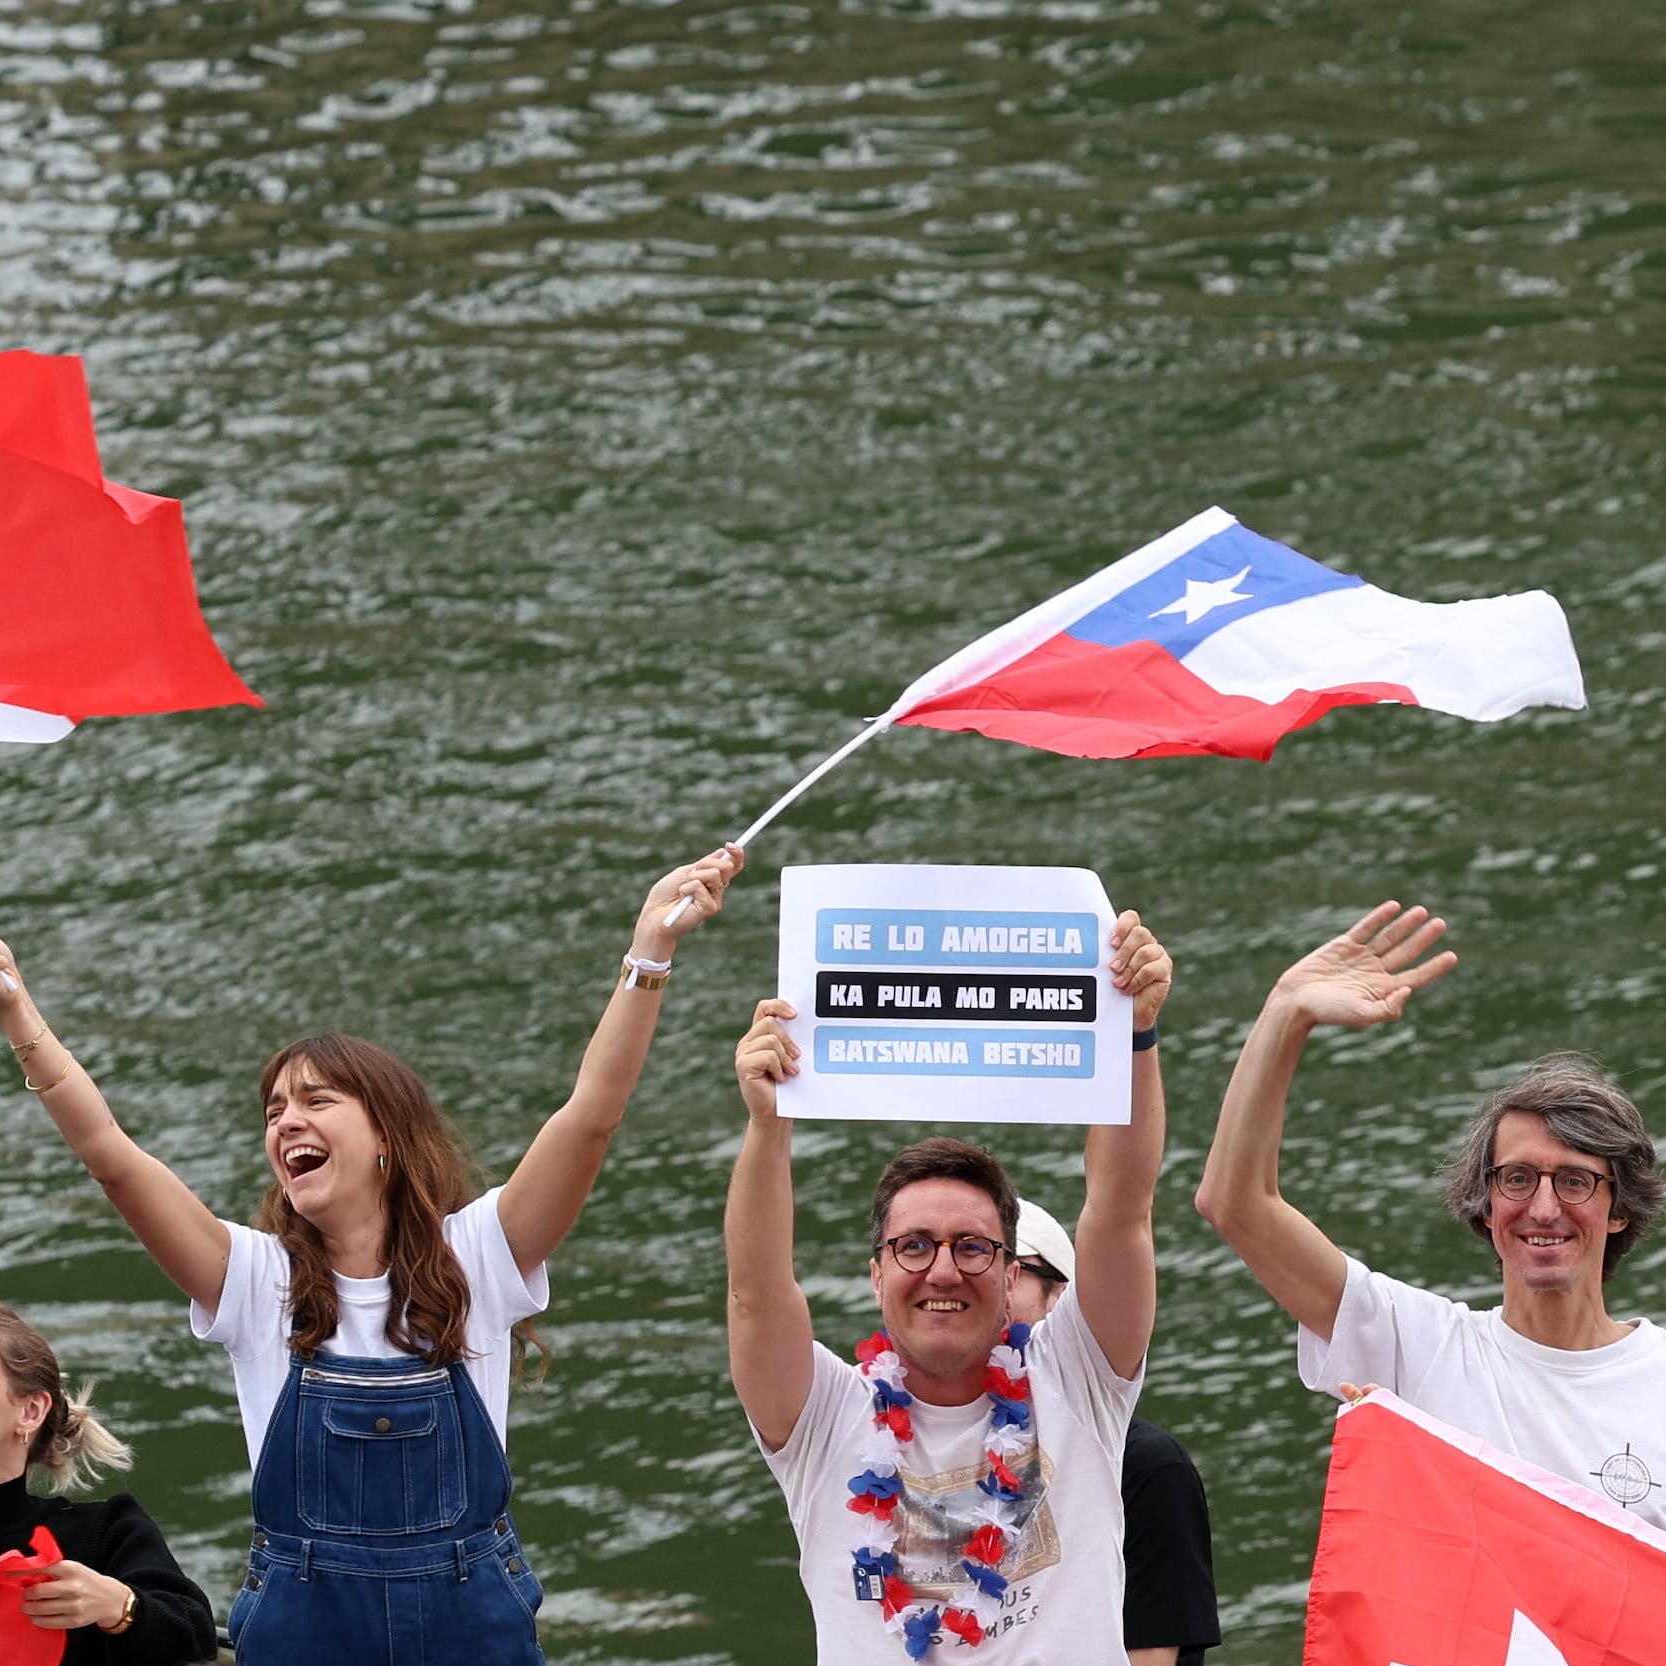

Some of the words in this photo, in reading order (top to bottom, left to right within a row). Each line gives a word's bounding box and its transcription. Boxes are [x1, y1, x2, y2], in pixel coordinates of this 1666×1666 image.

[832, 923, 872, 951] RE
[887, 925, 925, 951] LO
[940, 926, 1083, 955] AMOGELA
[829, 984, 864, 1007] KA
[877, 985, 943, 1009] PULA
[955, 986, 996, 1010] MO
[1009, 987, 1084, 1011] PARIS
[827, 1039, 969, 1065] BATSWANA
[983, 1042, 1081, 1067] BETSHO
